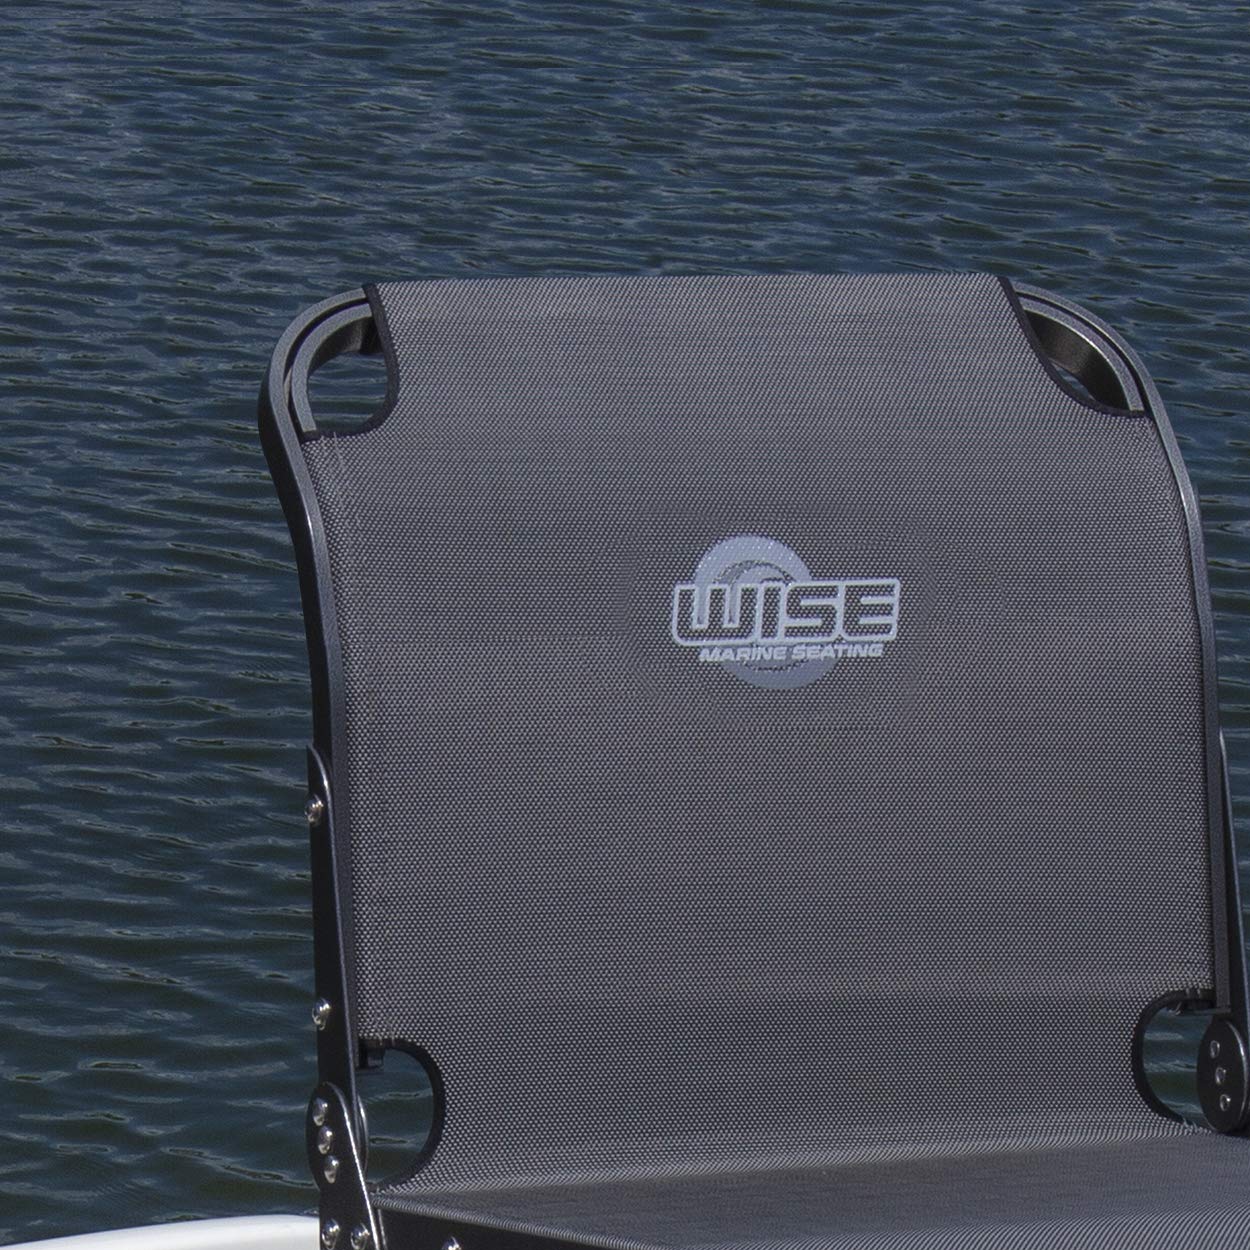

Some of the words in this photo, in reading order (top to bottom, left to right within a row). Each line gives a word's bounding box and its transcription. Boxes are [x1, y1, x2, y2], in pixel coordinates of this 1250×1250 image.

[671, 578, 900, 646] WISE
[700, 646, 787, 661] MARINE
[791, 643, 884, 660] SEATING
